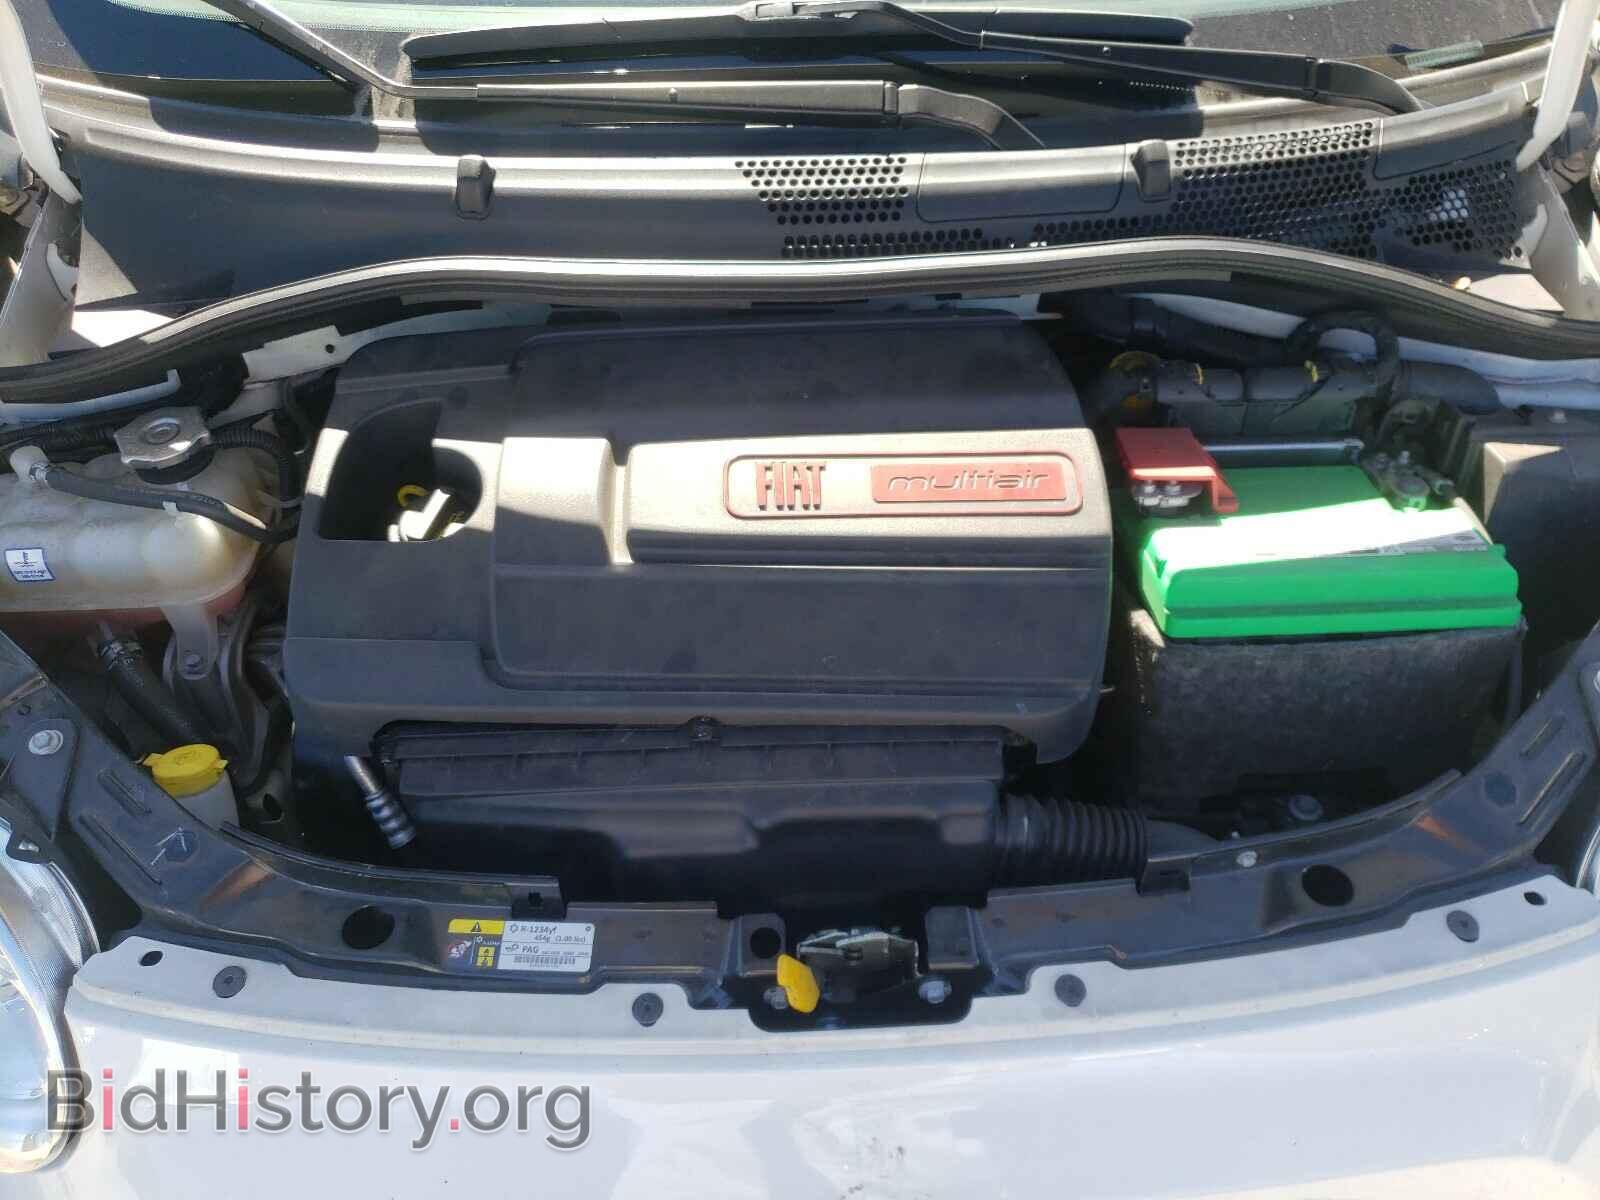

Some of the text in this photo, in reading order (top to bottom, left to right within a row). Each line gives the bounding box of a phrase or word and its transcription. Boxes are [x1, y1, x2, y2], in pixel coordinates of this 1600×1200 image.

[755, 461, 1049, 511] FIAT multiair
[522, 945, 539, 954] PAG
